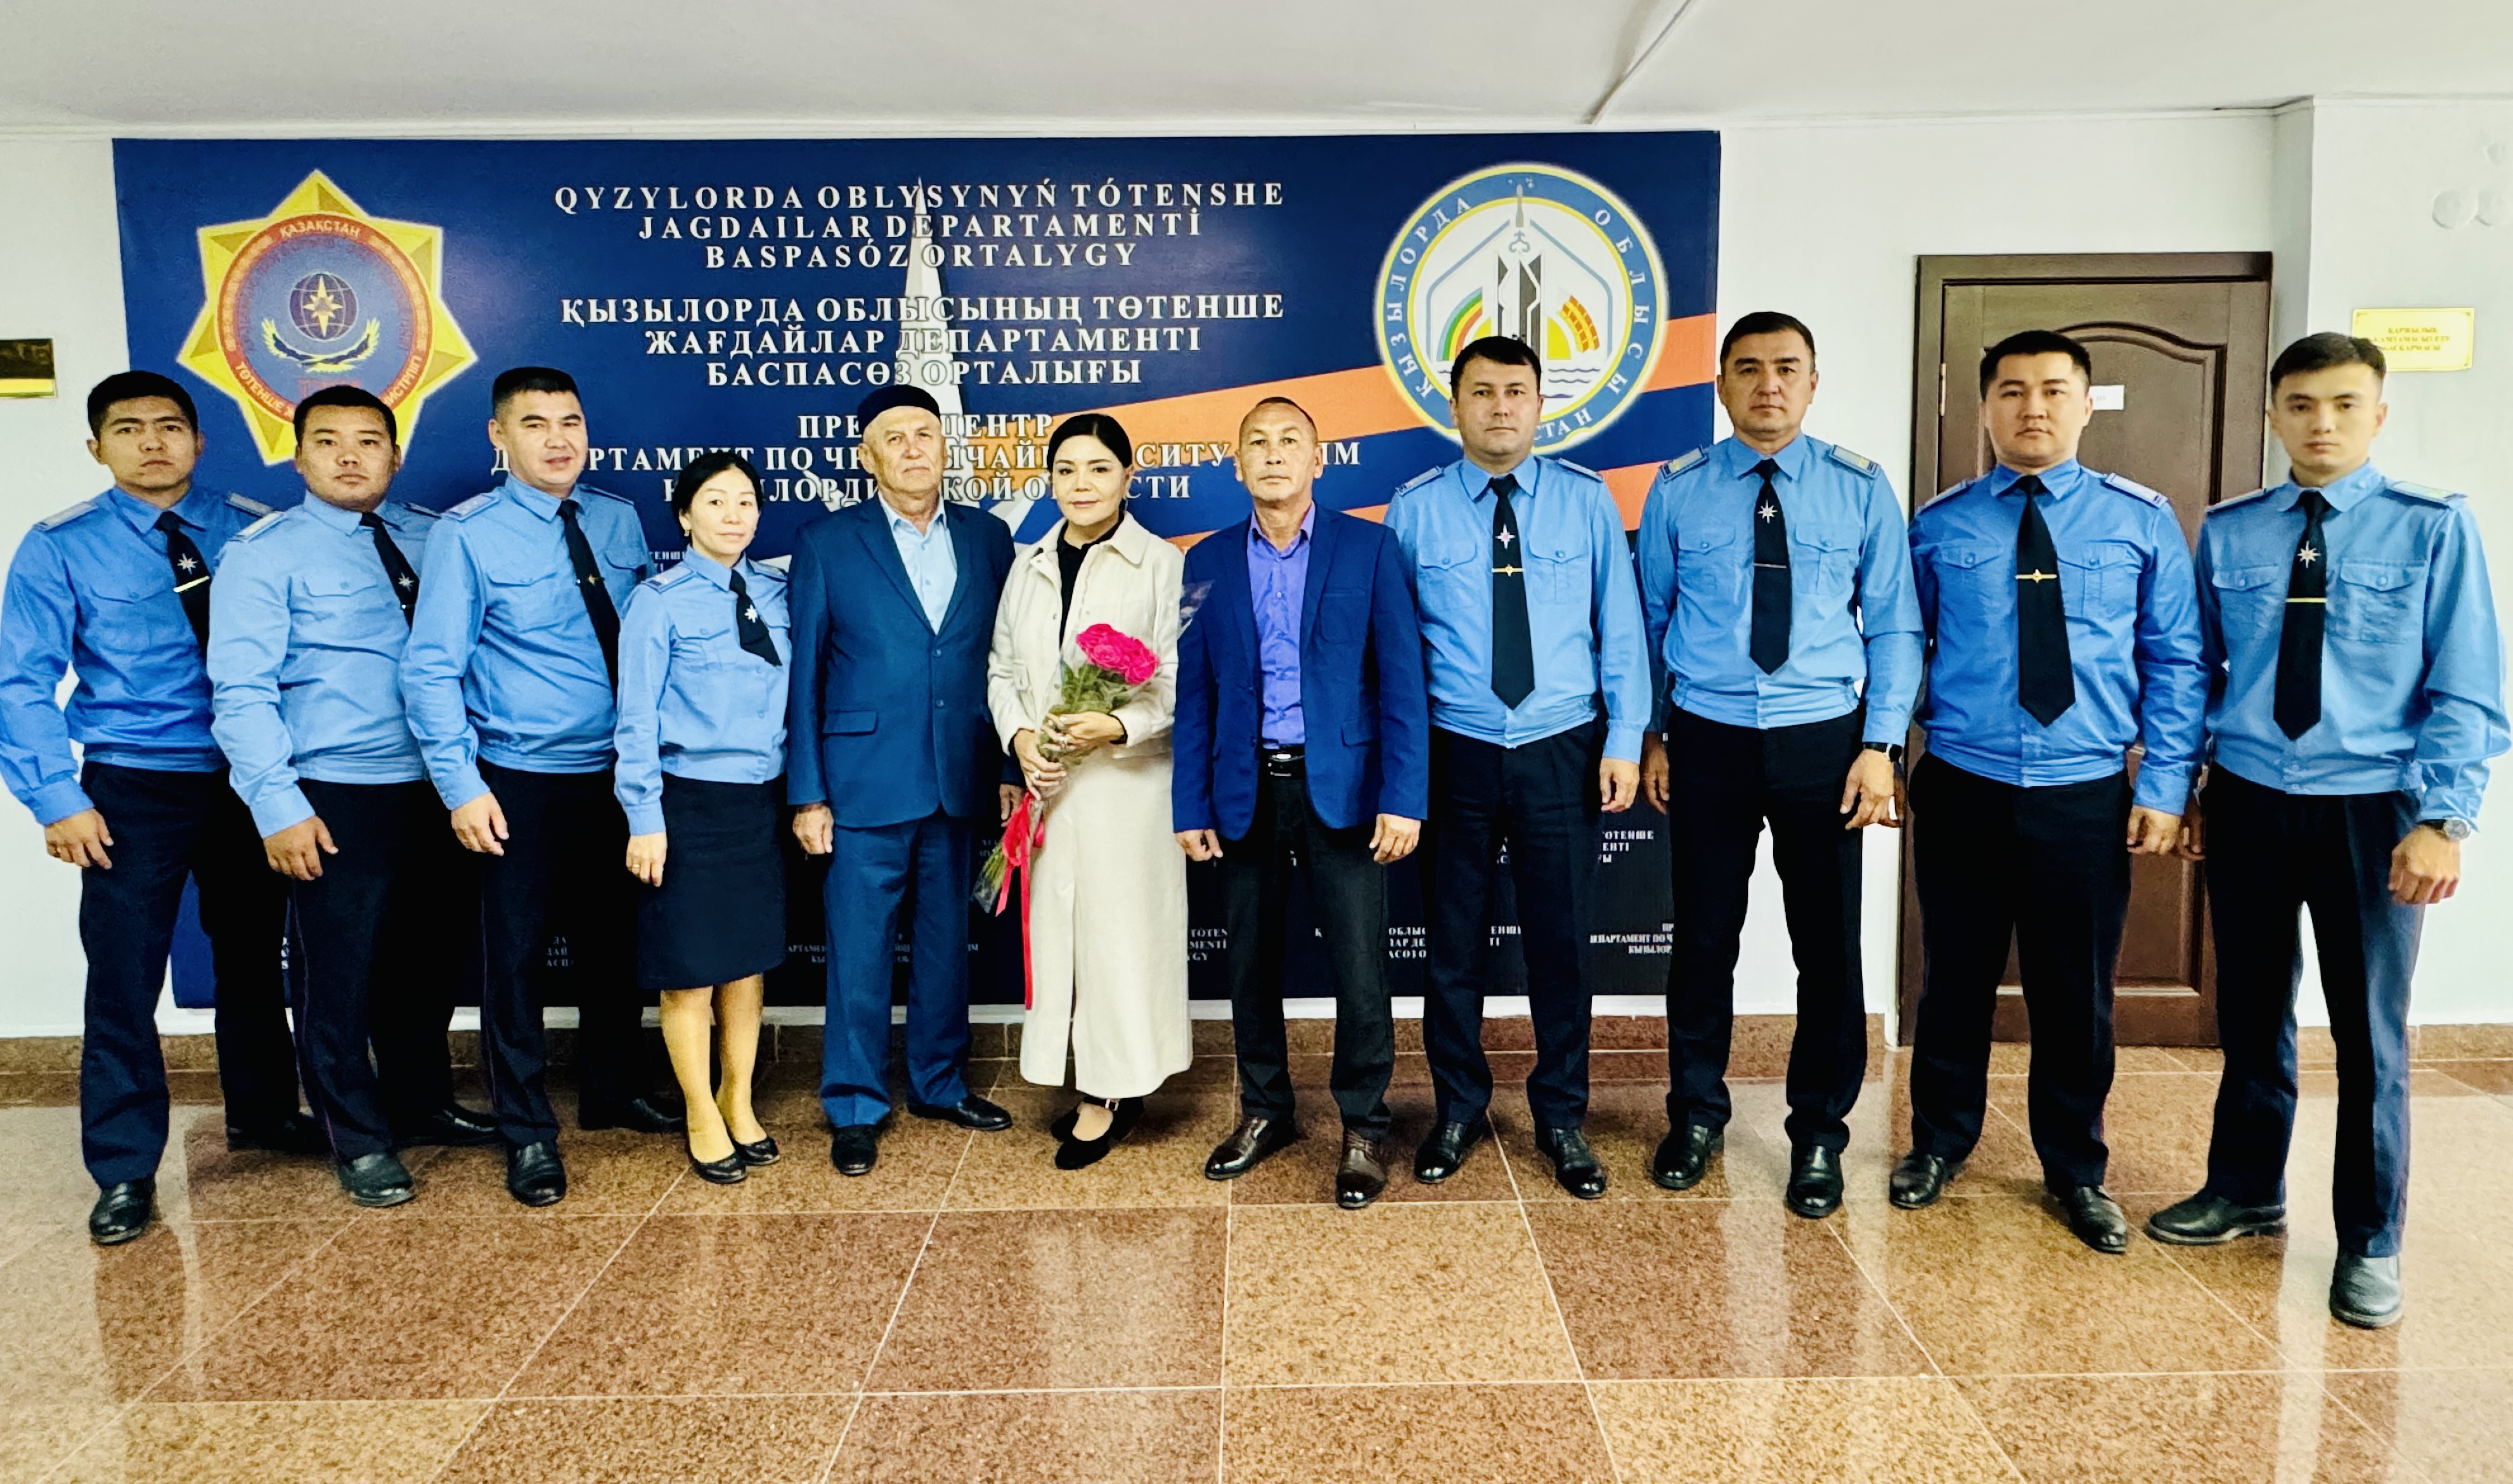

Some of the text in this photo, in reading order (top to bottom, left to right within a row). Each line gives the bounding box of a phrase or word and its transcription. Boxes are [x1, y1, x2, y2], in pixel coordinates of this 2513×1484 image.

[555, 177, 1283, 214] QYZYLORDA OBLYSYNYŃ TÓTENSHE
[638, 216, 872, 240] JAGDAILAR
[706, 238, 1136, 268] BASPASÓZ ORTALYGY
[560, 294, 1284, 327] ҚЫЗЫЛОРДА ОБЛЫСЫНЫҢ ТӨТЕНШЕ
[1594, 210, 1650, 394] ОБЛЫСЫ
[645, 325, 1201, 359] ЖАҒДАЙЛАР ДЕПАРТАМЕНТІ
[707, 359, 1140, 386] БАСПАСӨЗ ОРТАЛЫҒЫ
[765, 447, 813, 471] ПО
